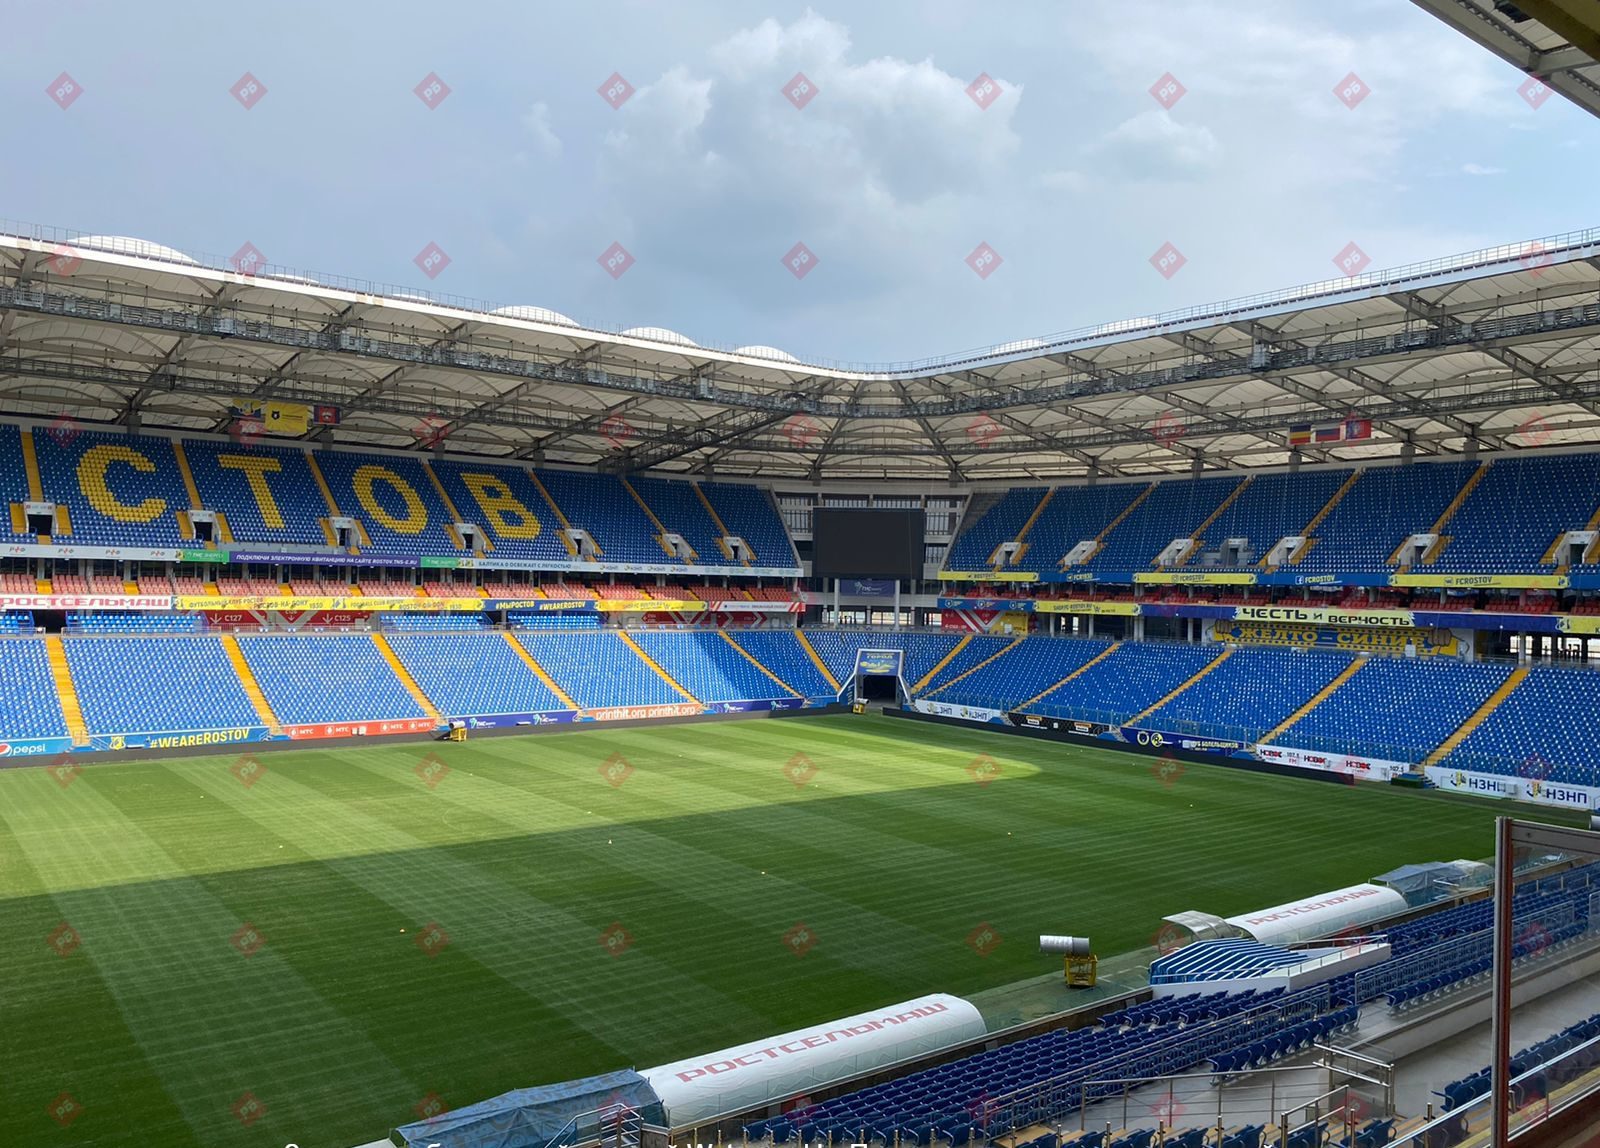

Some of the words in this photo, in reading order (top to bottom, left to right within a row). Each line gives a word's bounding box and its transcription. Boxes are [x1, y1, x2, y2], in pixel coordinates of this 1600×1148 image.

[1304, 575, 1335, 584] FCROSTOV
[1455, 576, 1493, 585] FCROSTOV
[0, 597, 170, 610] РОСТСЕЛЬМАШ
[496, 600, 535, 609] #МЫРОСТОВ
[539, 601, 586, 610] #WEAREROSTOV
[1242, 607, 1308, 620] ЧЕСТЬ
[1328, 615, 1410, 626] ВЕРНОСТЬ
[1239, 627, 1318, 642] ЖЕЛТО
[1337, 634, 1425, 648] СИНИЕ
[596, 709, 647, 720] printhit.org
[648, 705, 696, 717] printhit.org
[389, 722, 403, 730] МТС
[150, 728, 250, 749] #WEAREROSTOV
[13, 743, 46, 755] pepsi
[1546, 787, 1588, 804] НЗНП
[1247, 887, 1380, 926] РОСТСЕЛЬМАШ
[674, 1002, 950, 1083] РОСТСЕЛЬМАШ
